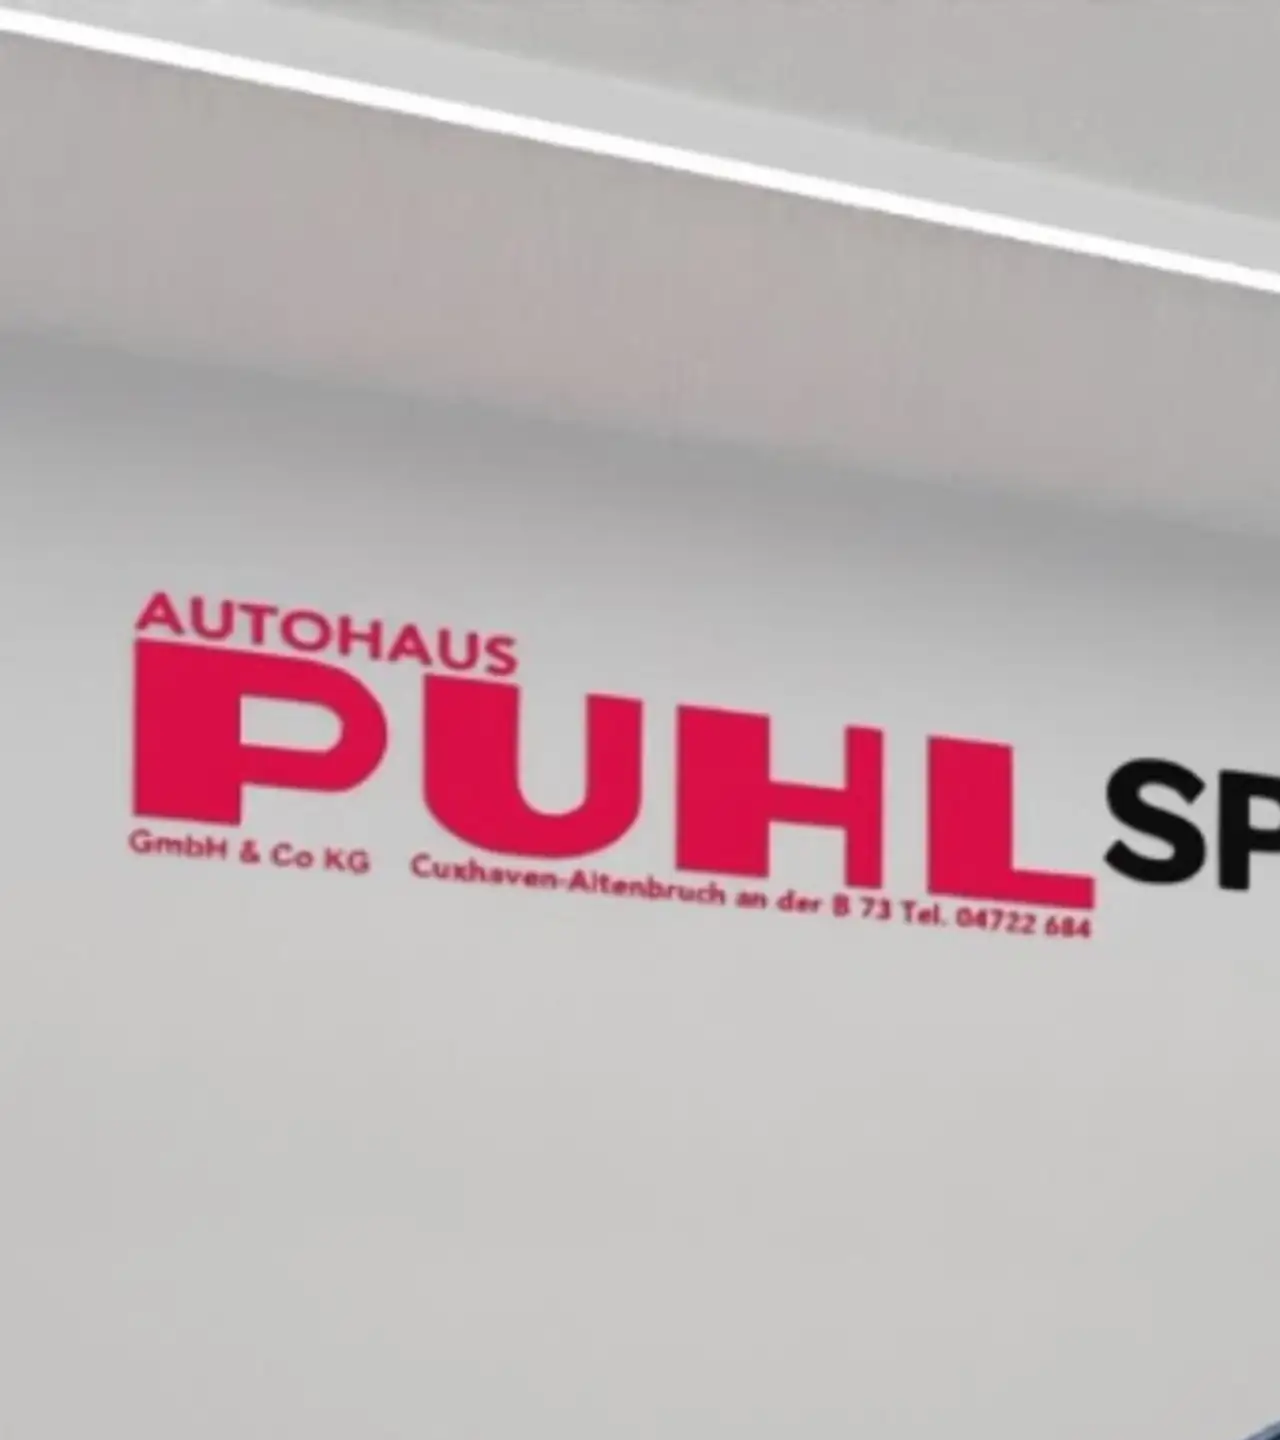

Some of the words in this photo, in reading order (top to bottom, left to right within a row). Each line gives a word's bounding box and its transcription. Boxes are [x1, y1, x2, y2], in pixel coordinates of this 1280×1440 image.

[136, 592, 520, 676] AUTOHAUS
[132, 636, 1096, 911] PUHL
[128, 828, 228, 860] GmbH
[239, 839, 261, 864] &
[270, 842, 315, 869] Co
[323, 847, 370, 875] KG
[410, 852, 726, 906] Cuxhaven-Altenbruch
[736, 889, 767, 910] an
[776, 889, 823, 914] der
[833, 893, 850, 918] B
[861, 896, 892, 921] 73
[902, 899, 948, 928] Tel.
[955, 907, 1036, 935] 04722
[1045, 915, 1092, 939] 684
